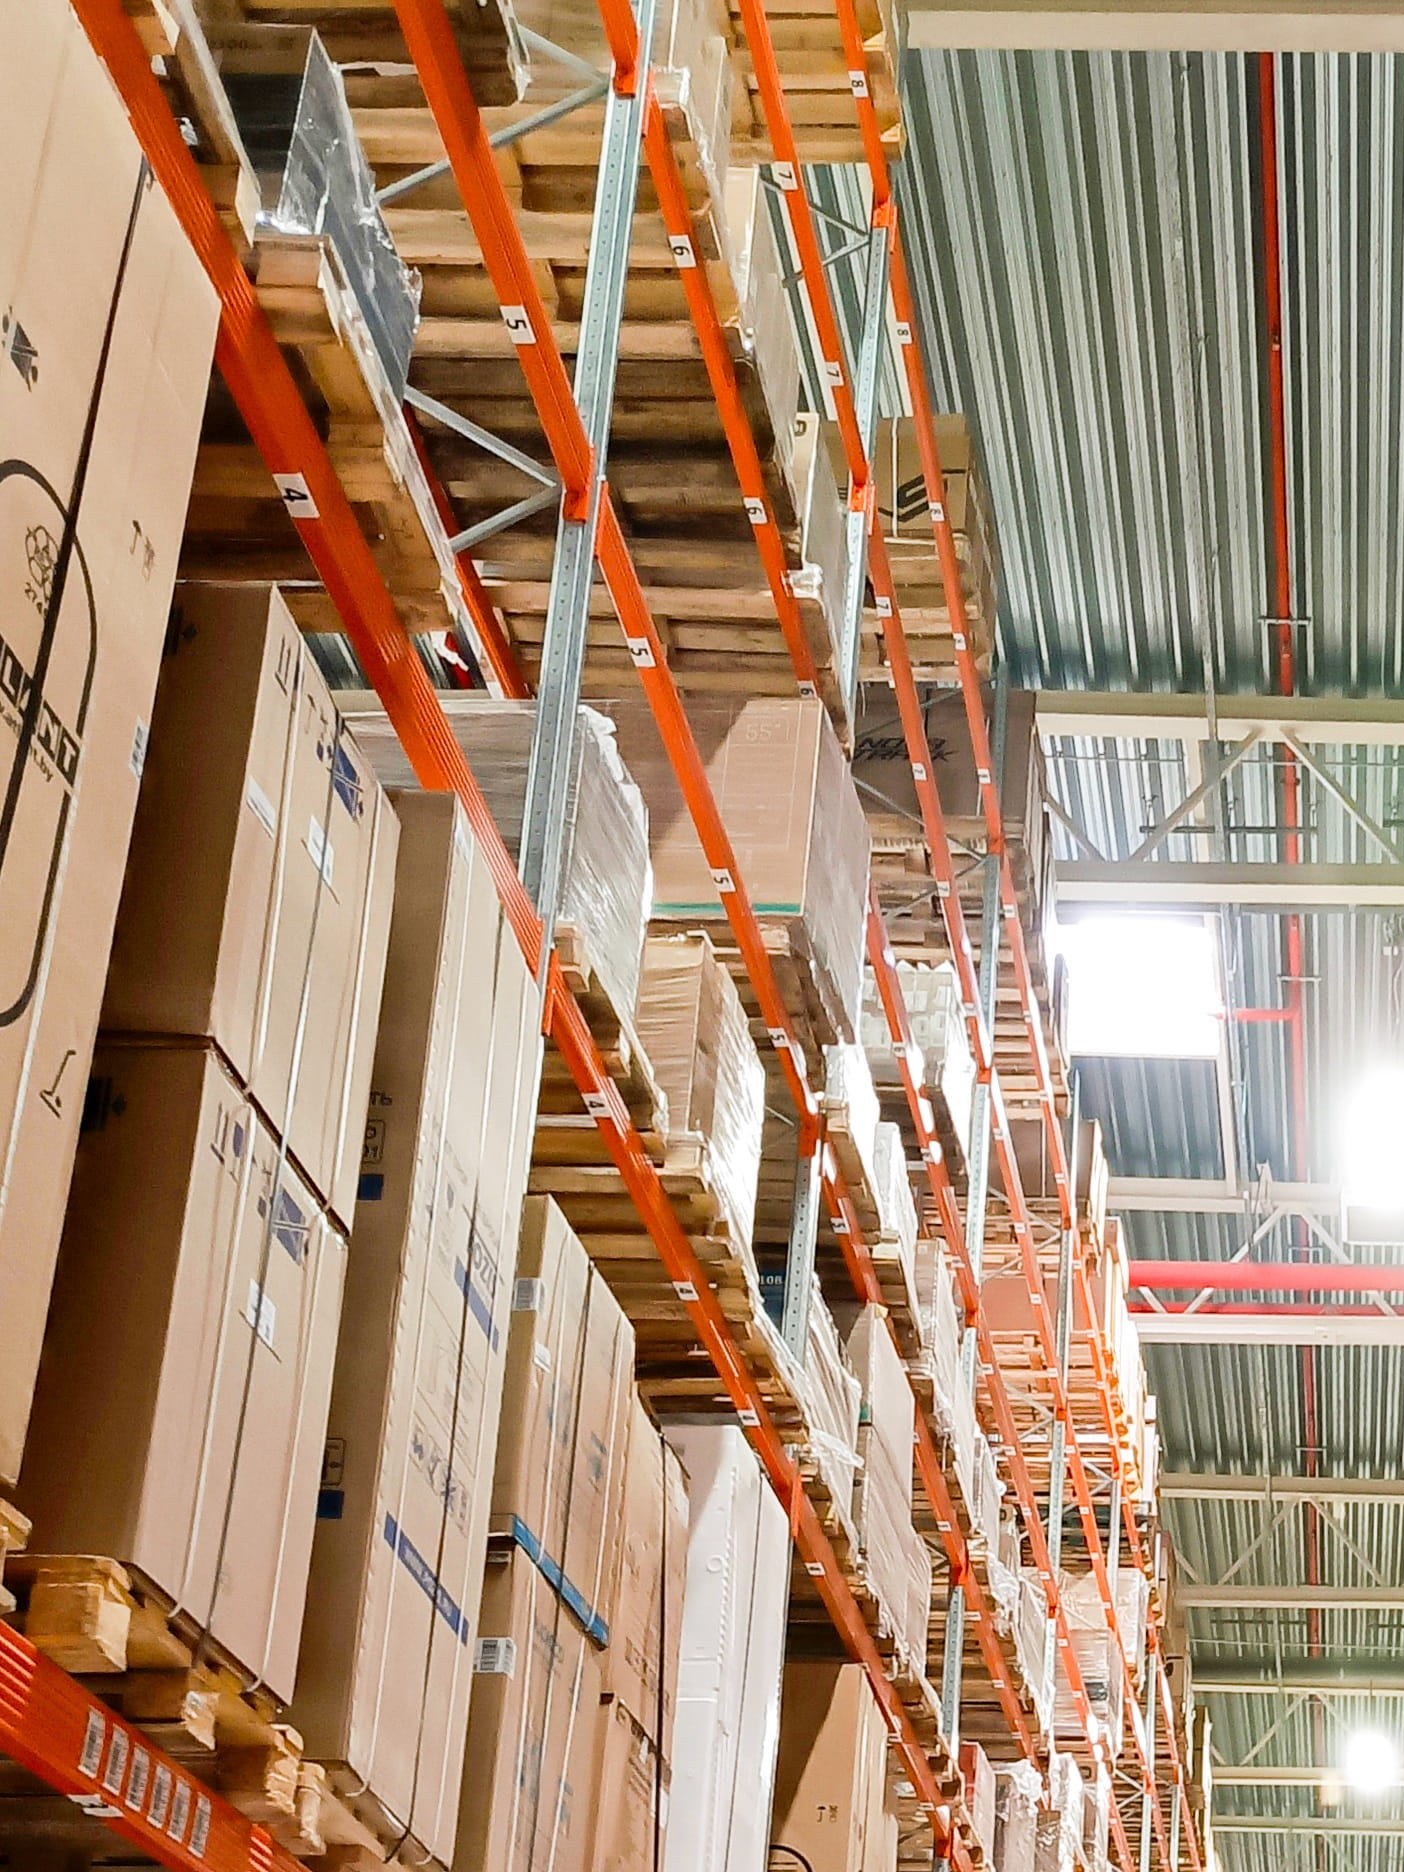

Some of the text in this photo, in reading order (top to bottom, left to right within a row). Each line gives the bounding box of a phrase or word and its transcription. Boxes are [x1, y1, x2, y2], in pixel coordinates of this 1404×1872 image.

[851, 79, 864, 88] 8
[778, 170, 793, 181] 7
[673, 245, 690, 256] 6
[506, 318, 526, 330] 5
[826, 369, 840, 378] 7
[284, 487, 308, 502] 4
[748, 506, 763, 516] 6
[630, 647, 648, 657] 5
[713, 876, 730, 884] 5
